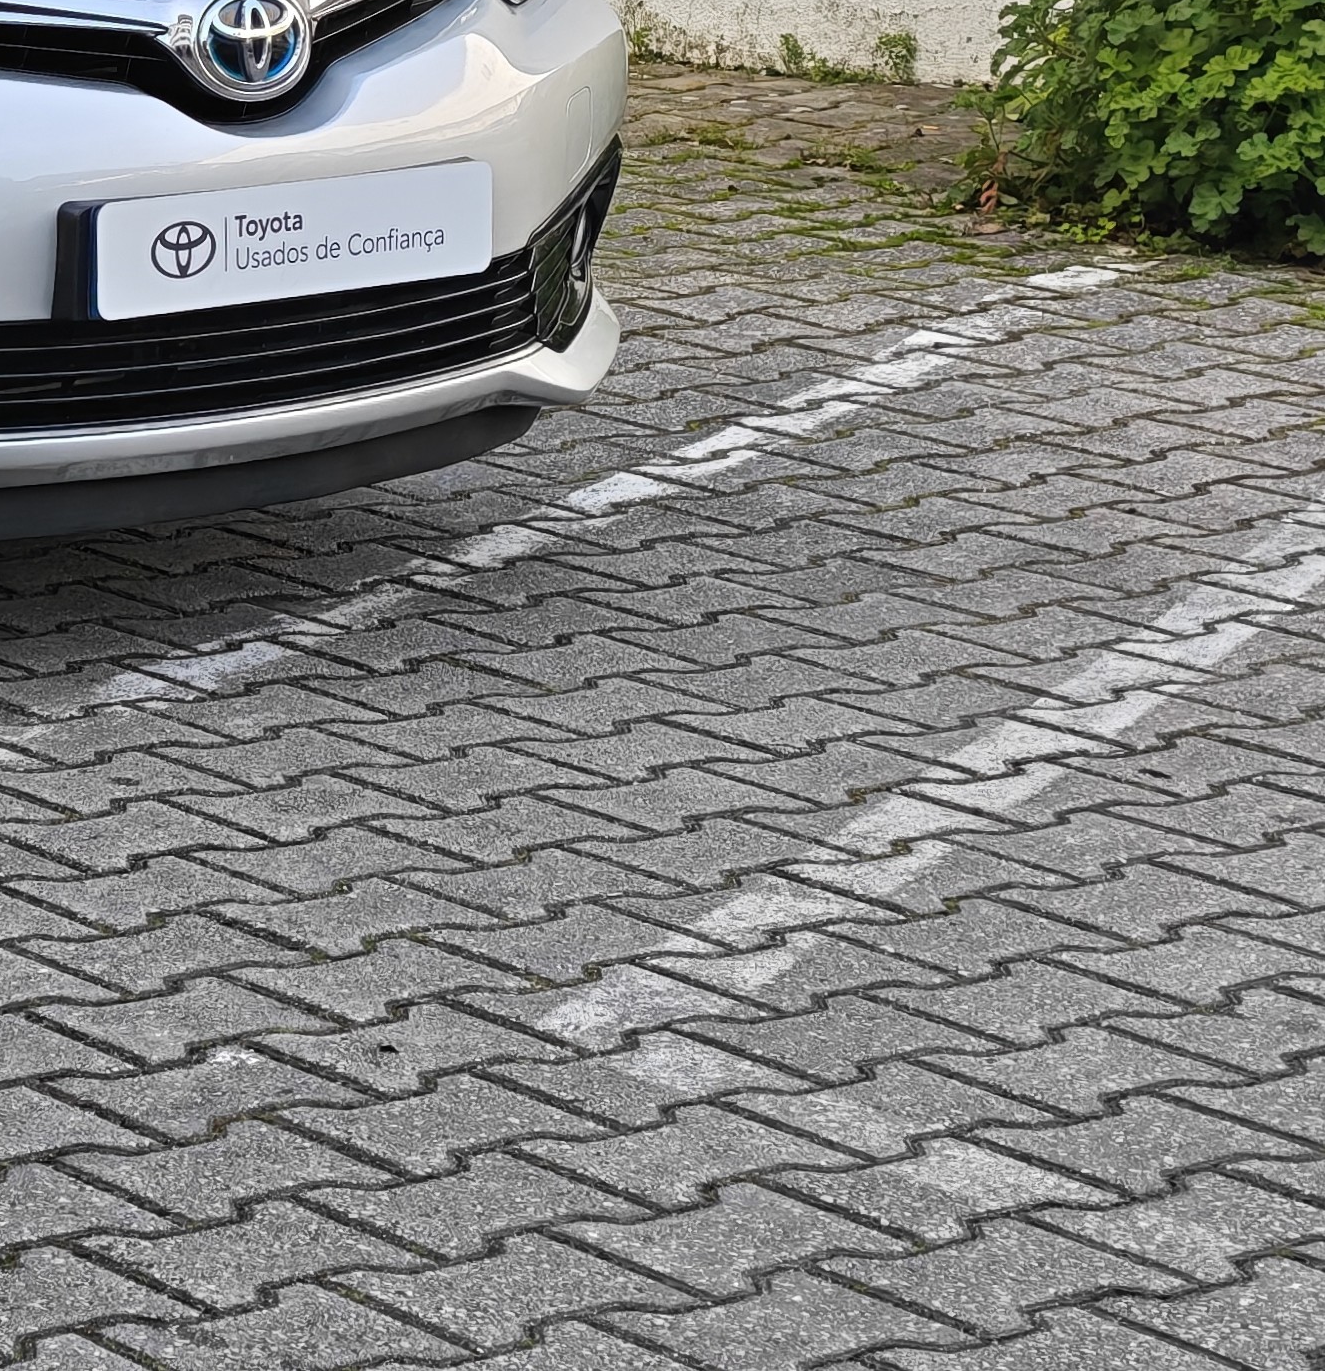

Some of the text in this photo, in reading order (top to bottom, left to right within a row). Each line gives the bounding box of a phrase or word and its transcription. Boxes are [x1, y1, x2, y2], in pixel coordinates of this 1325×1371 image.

[235, 211, 303, 241] Toyota
[236, 227, 445, 270] Usados de Confiança
